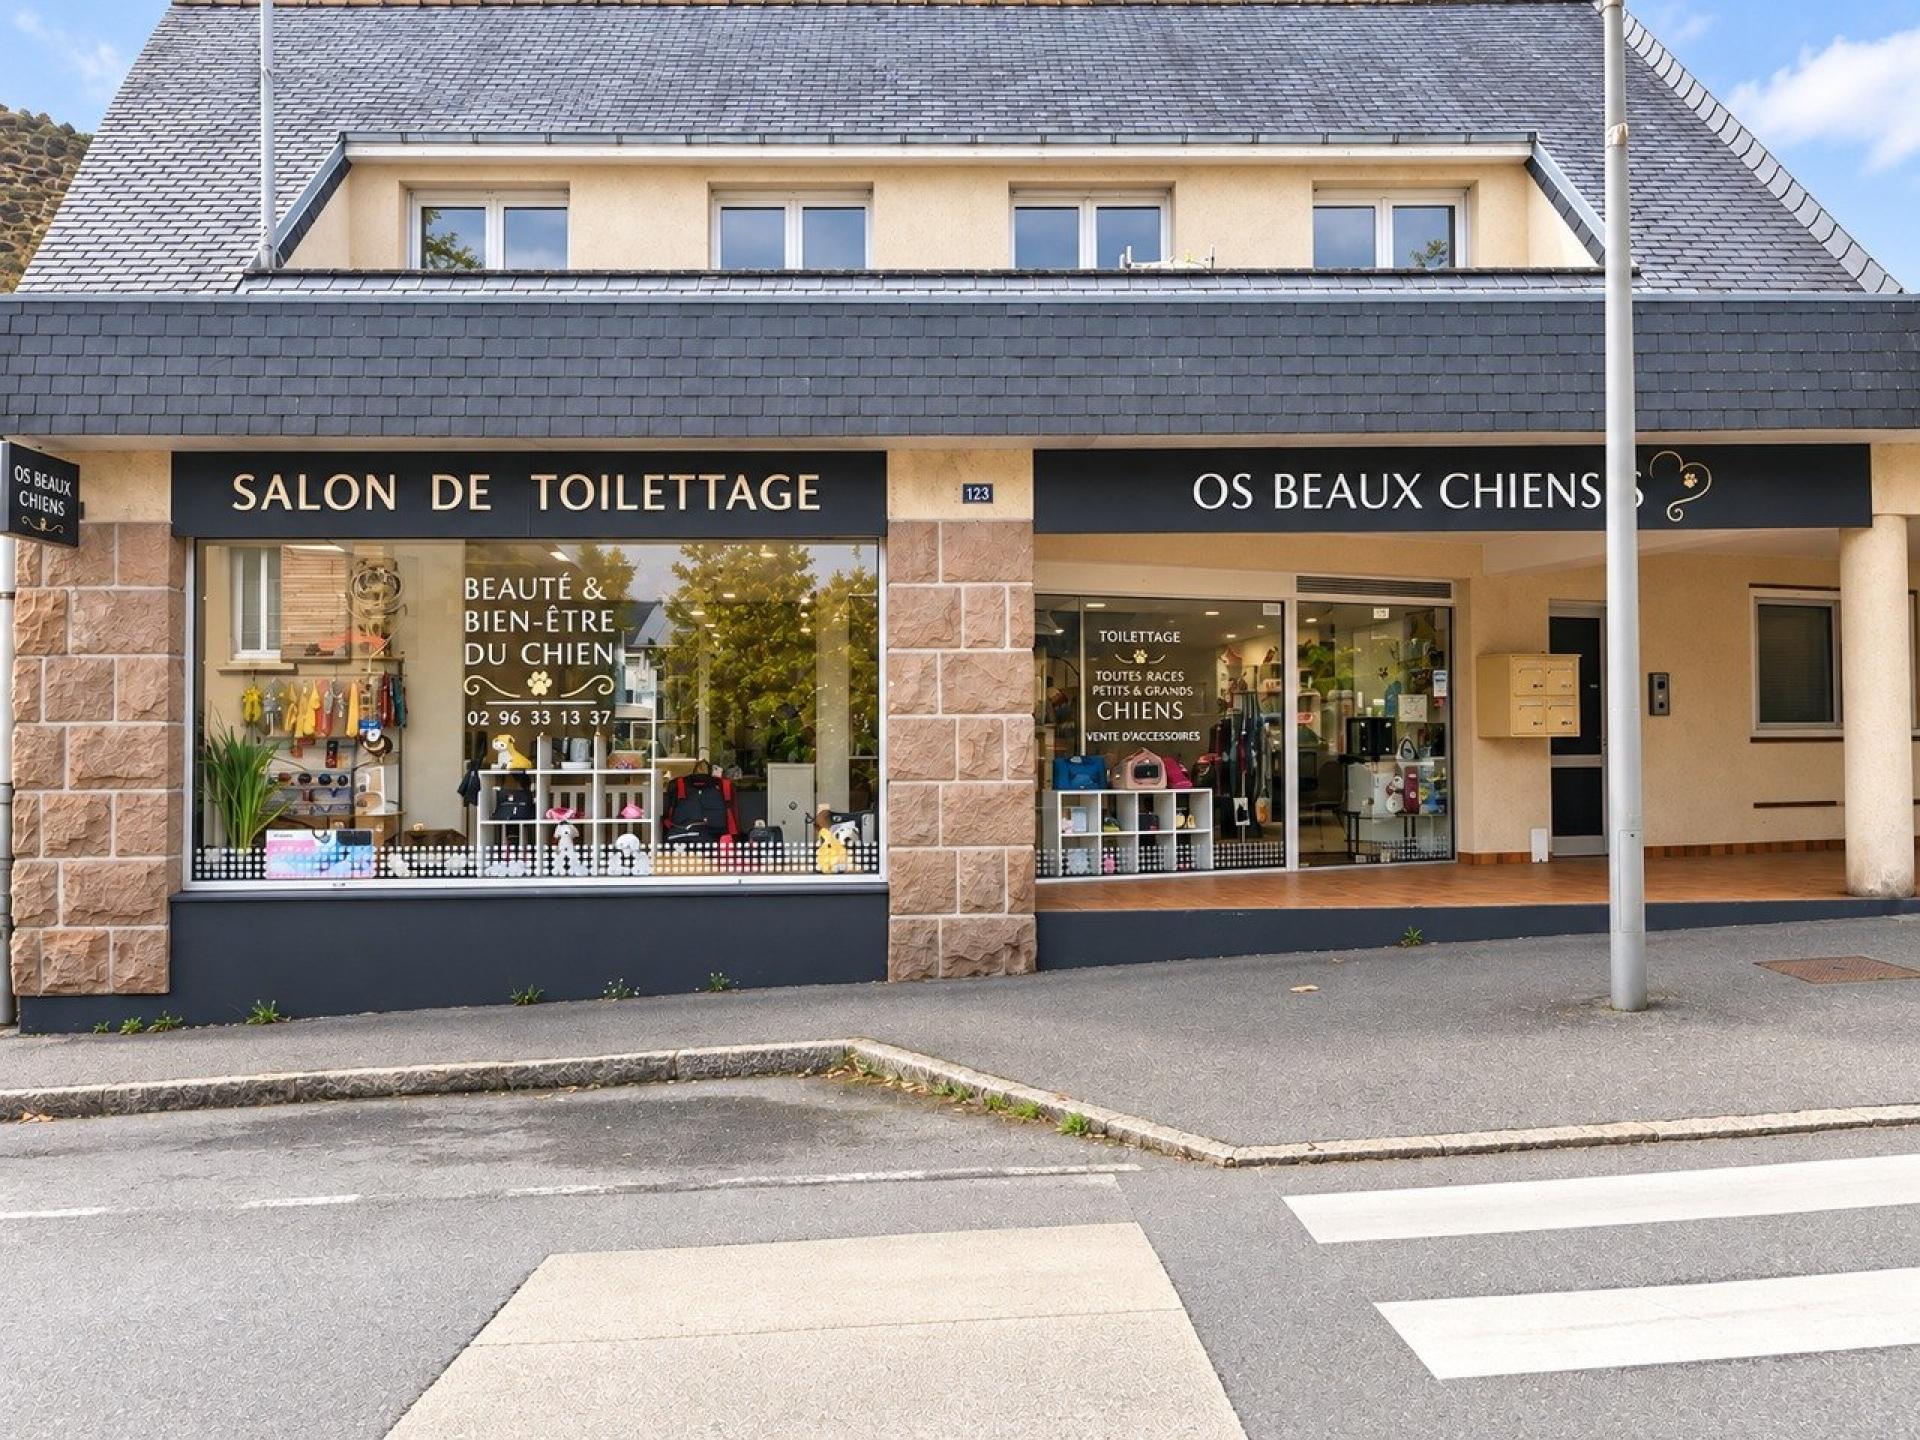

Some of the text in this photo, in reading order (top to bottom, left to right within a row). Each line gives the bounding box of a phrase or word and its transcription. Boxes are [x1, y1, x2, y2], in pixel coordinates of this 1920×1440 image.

[14, 464, 71, 497] OS BEAUX
[1193, 473, 1254, 509] OS
[1274, 473, 1422, 509] BEAUX
[19, 490, 65, 516] CHIENS
[232, 474, 821, 511] SALON DE TOILETTAGE
[966, 486, 989, 500] 123
[464, 572, 607, 600] BEAUTÉ &
[464, 604, 615, 632] BIEN-ÊTRE
[1099, 630, 1180, 642] TOILETTAGE
[464, 642, 613, 665] DU CHIEN
[1096, 671, 1184, 682] TOUTES RACES
[1092, 686, 1193, 697] PETITS & GRANDS
[467, 711, 612, 725] 02 96 33 13 37
[1097, 701, 1183, 720] CHIENS
[1087, 731, 1201, 741] VENTE D'ACCESSOIRES
